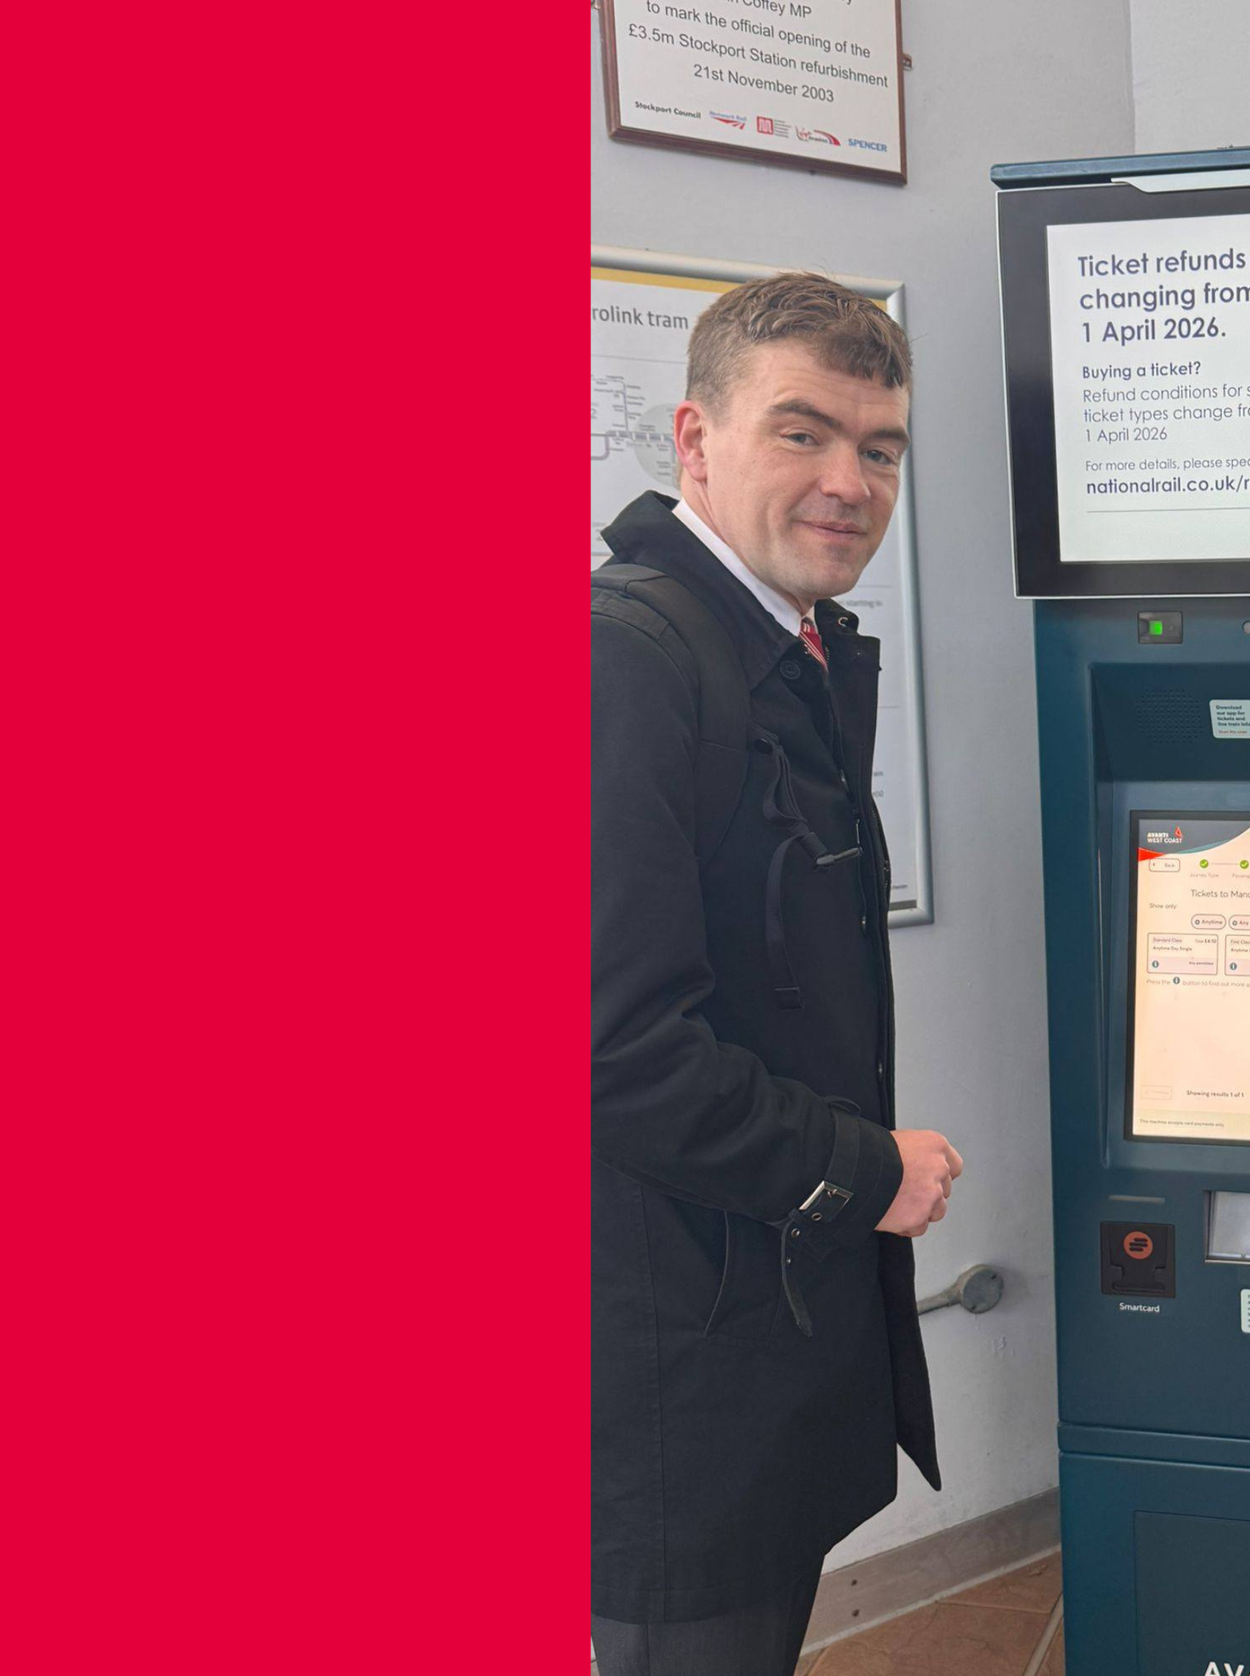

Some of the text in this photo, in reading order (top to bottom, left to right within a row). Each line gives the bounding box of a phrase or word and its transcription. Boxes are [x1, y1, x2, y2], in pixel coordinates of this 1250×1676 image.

[790, 3, 812, 18] MP
[646, 1, 871, 58] to mark the official opening of the
[629, 23, 888, 87] £3.5m Stockport Station refurbishment
[693, 64, 835, 102] 21st November 2003
[635, 101, 701, 119] Stockport Council
[848, 138, 887, 152] SPENCER
[1078, 253, 1149, 277] Ticket
[1156, 248, 1246, 273] refunds
[1080, 285, 1196, 312] changing
[648, 311, 689, 330] tram
[1082, 316, 1226, 346] 1 April 2026.
[1082, 361, 1201, 381] Buying a ticket?
[1083, 386, 1136, 403] Refund
[1140, 385, 1218, 401] conditions
[1222, 383, 1243, 398] for
[1083, 408, 1124, 423] ticket
[1129, 407, 1168, 424] types
[1173, 405, 1233, 422] change
[1085, 427, 1167, 445] 1 April 2026
[1085, 460, 1103, 471] For
[1105, 461, 1136, 471] more
[1138, 458, 1180, 471] details,
[1183, 457, 1223, 471] please
[1191, 889, 1218, 898] Tickets
[1220, 890, 1229, 898] to
[1119, 1302, 1160, 1313] Smartcard
